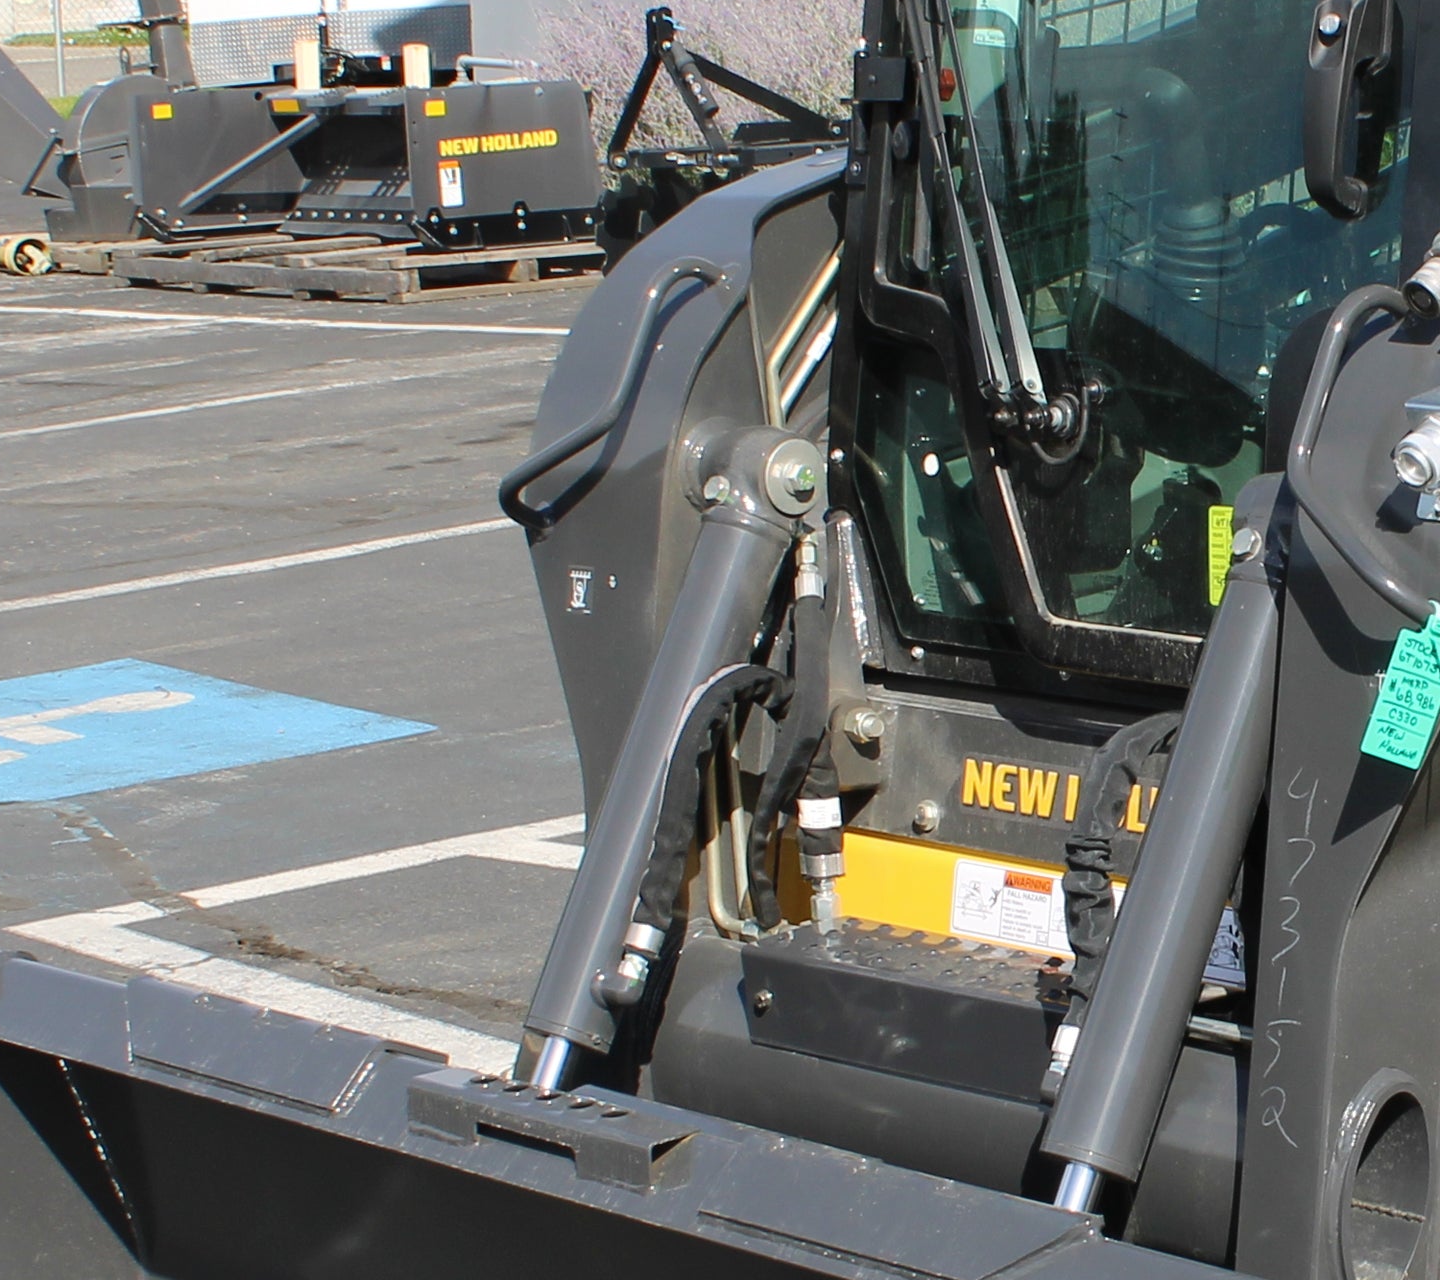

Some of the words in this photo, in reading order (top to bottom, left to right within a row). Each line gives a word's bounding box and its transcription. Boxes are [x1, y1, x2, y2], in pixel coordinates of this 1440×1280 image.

[439, 136, 479, 157] NEW
[481, 128, 559, 153] HOLLAND
[1388, 708, 1418, 726] C330
[1376, 725, 1406, 741] NEW
[962, 757, 1059, 819] NEW
[1012, 878, 1052, 893] WARNING
[1006, 889, 1023, 899] FALL
[1023, 891, 1048, 903] HAZARD
